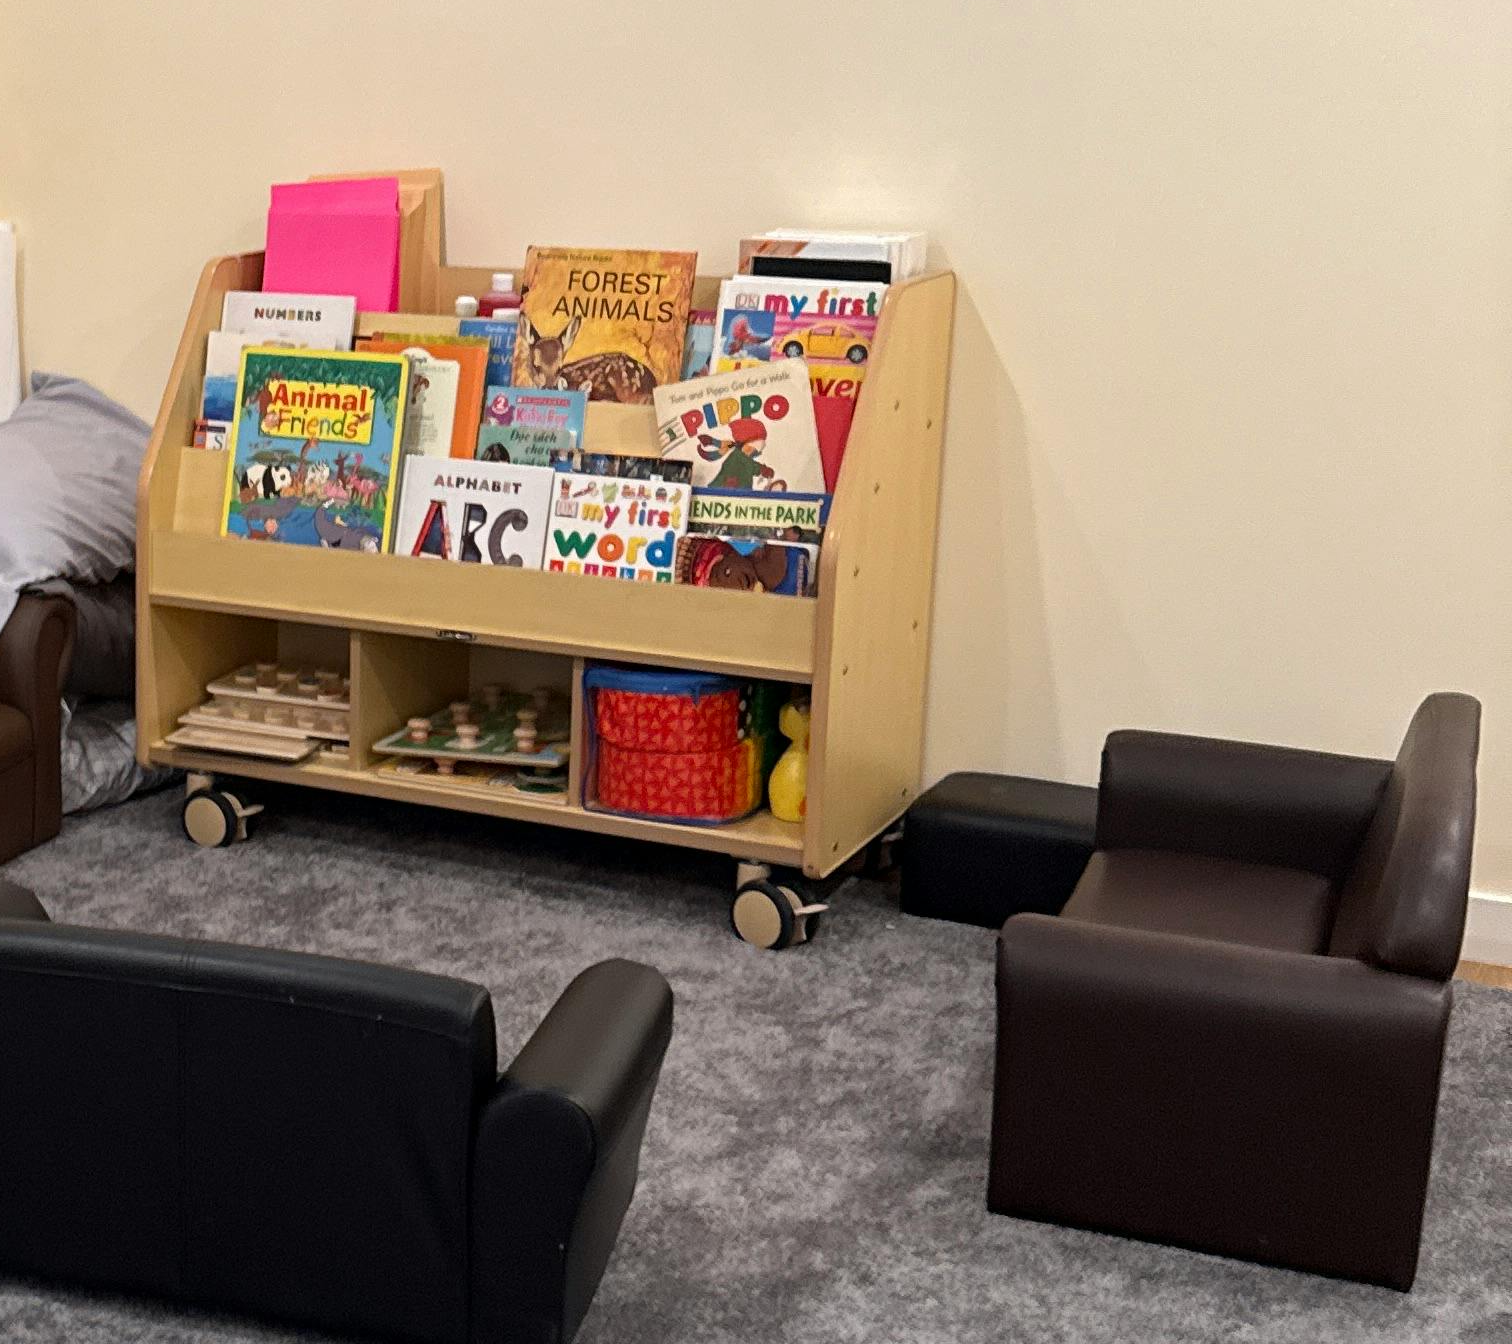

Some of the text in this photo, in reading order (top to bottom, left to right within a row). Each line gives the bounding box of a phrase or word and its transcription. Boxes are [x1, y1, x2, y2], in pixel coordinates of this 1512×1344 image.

[568, 270, 667, 296] FOREST
[254, 307, 322, 322] NUMBERS
[552, 296, 674, 323] ANIMALS
[764, 294, 808, 320] my
[817, 288, 877, 316] first
[272, 383, 367, 411] Animal
[706, 385, 729, 398] Pippo
[277, 410, 359, 438] Friends
[680, 394, 790, 438] PIPPO
[433, 474, 523, 494] ALPHABET
[582, 502, 621, 529] my
[627, 501, 682, 529] first
[735, 505, 749, 520] IN
[750, 506, 773, 521] THE
[775, 506, 816, 524] PARK
[412, 500, 529, 568] ABC
[553, 529, 676, 568] word
